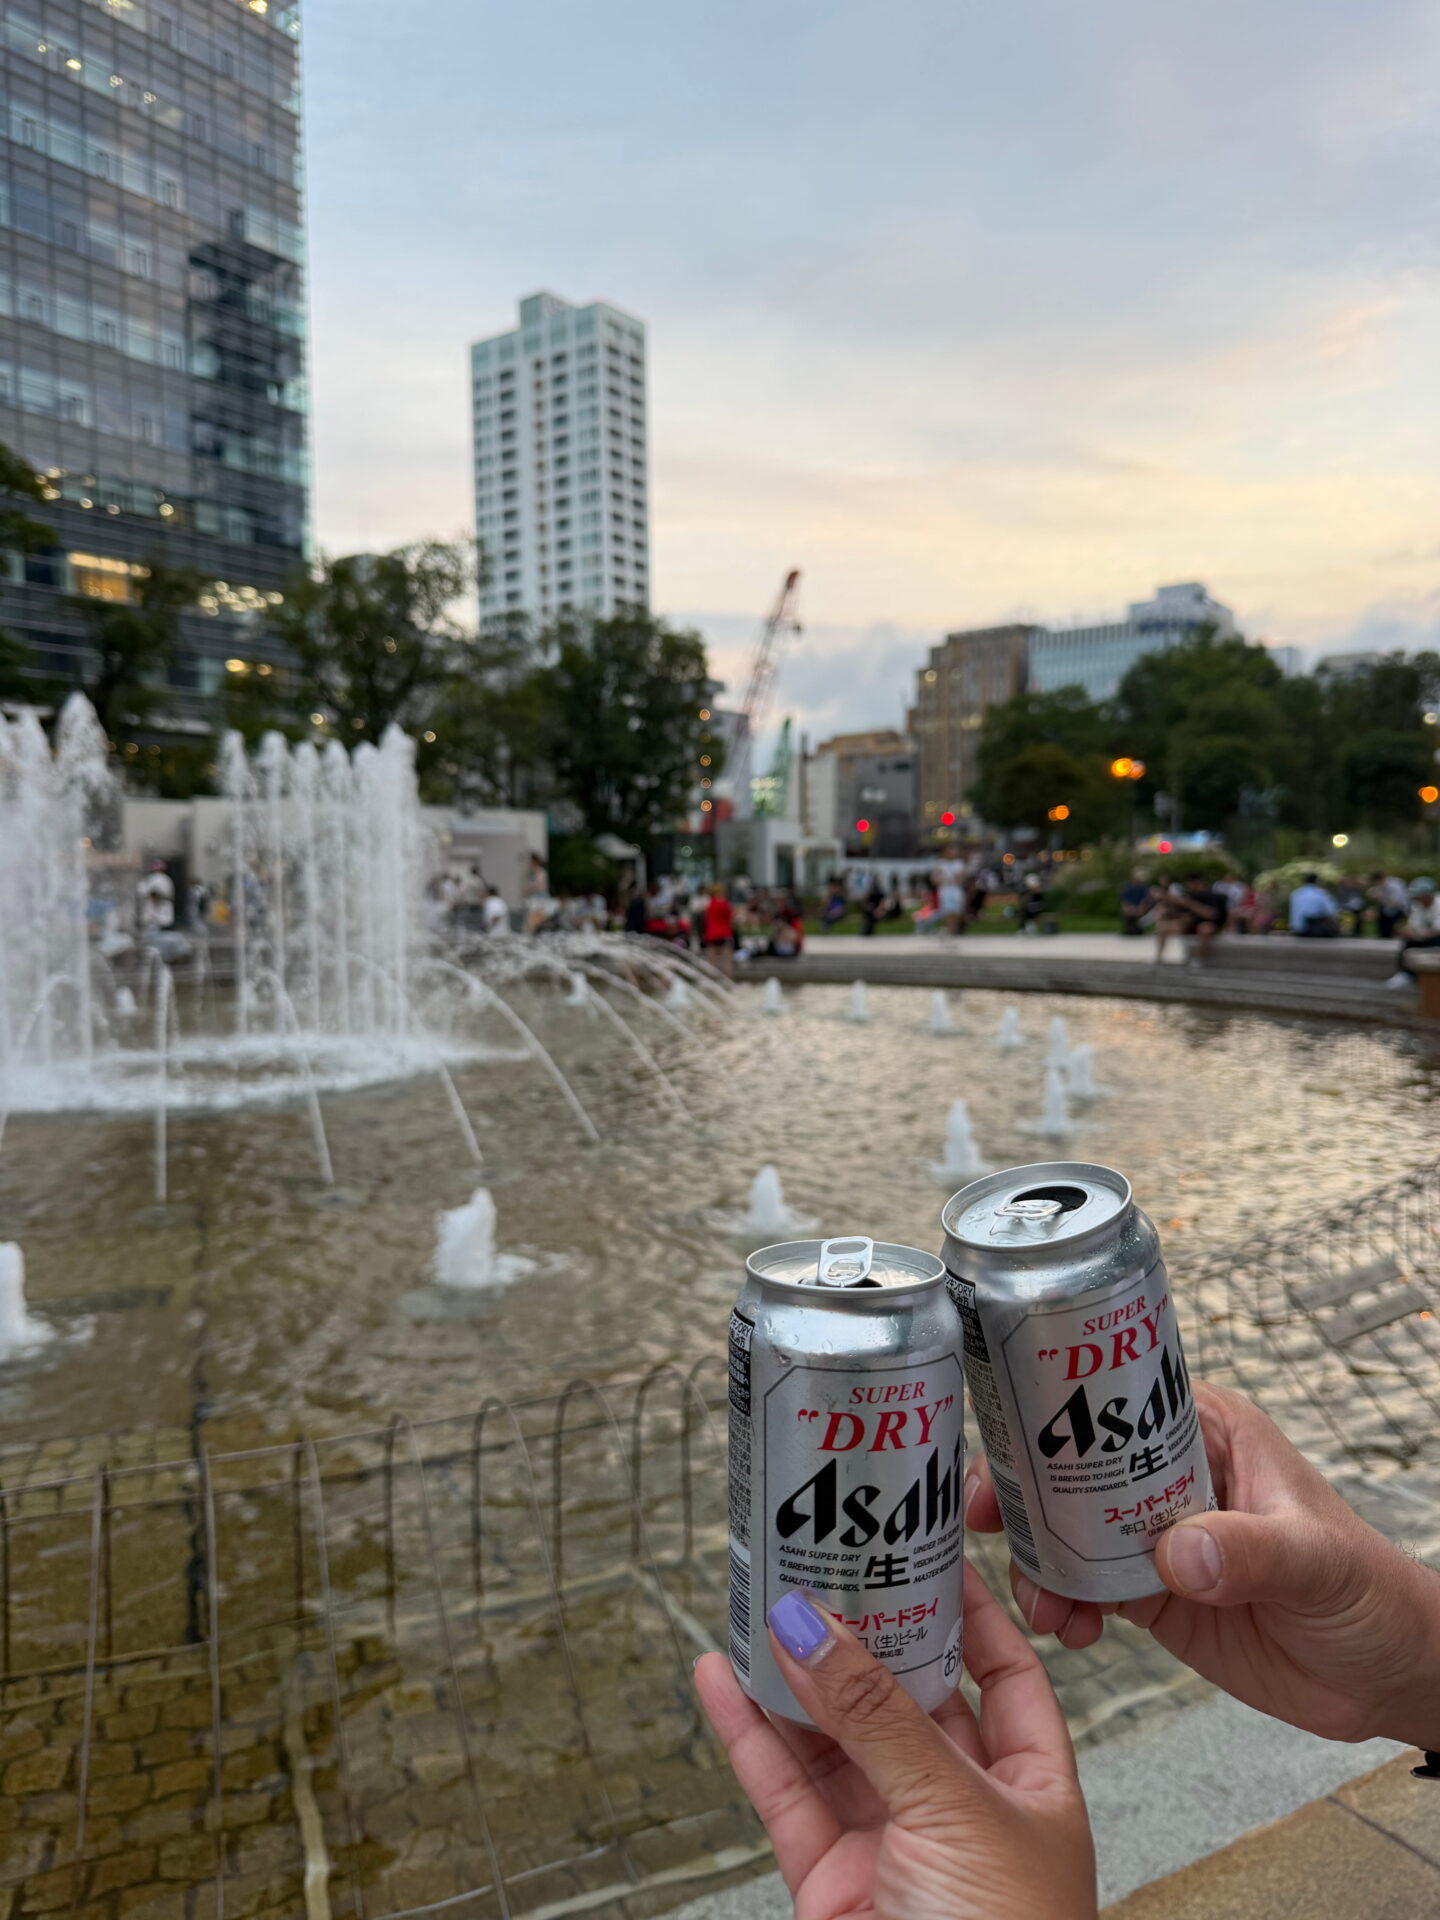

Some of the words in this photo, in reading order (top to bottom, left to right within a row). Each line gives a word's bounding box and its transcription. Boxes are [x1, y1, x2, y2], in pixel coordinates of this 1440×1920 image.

[1083, 1295, 1147, 1336] SUPER
[848, 1381, 925, 1405] SUPER
[1047, 1463, 1074, 1471] ASAHI
[1075, 1461, 1104, 1471] SUPER
[1105, 1455, 1124, 1467] DRY
[1129, 1443, 1169, 1483] 生
[1050, 1474, 1057, 1482] IS
[1058, 1474, 1091, 1483] BREWED
[1092, 1472, 1103, 1481] TO
[1104, 1467, 1125, 1480] HIGH
[776, 1431, 960, 1548] Asahi
[1052, 1486, 1084, 1495] QUALITY
[1104, 1465, 1195, 1524] スーパードライ
[779, 1545, 806, 1557] ASAHI
[807, 1551, 839, 1561] SUPER
[840, 1554, 861, 1562] DRY
[913, 1540, 936, 1555] UNDER
[779, 1559, 787, 1567] IS
[787, 1561, 822, 1574] BREWED
[823, 1567, 835, 1575] TO
[835, 1568, 860, 1577] HIGH
[913, 1555, 935, 1569] VISION
[779, 1573, 811, 1587] QUALITY
[864, 1553, 910, 1590] 生
[913, 1567, 940, 1584] MASTER
